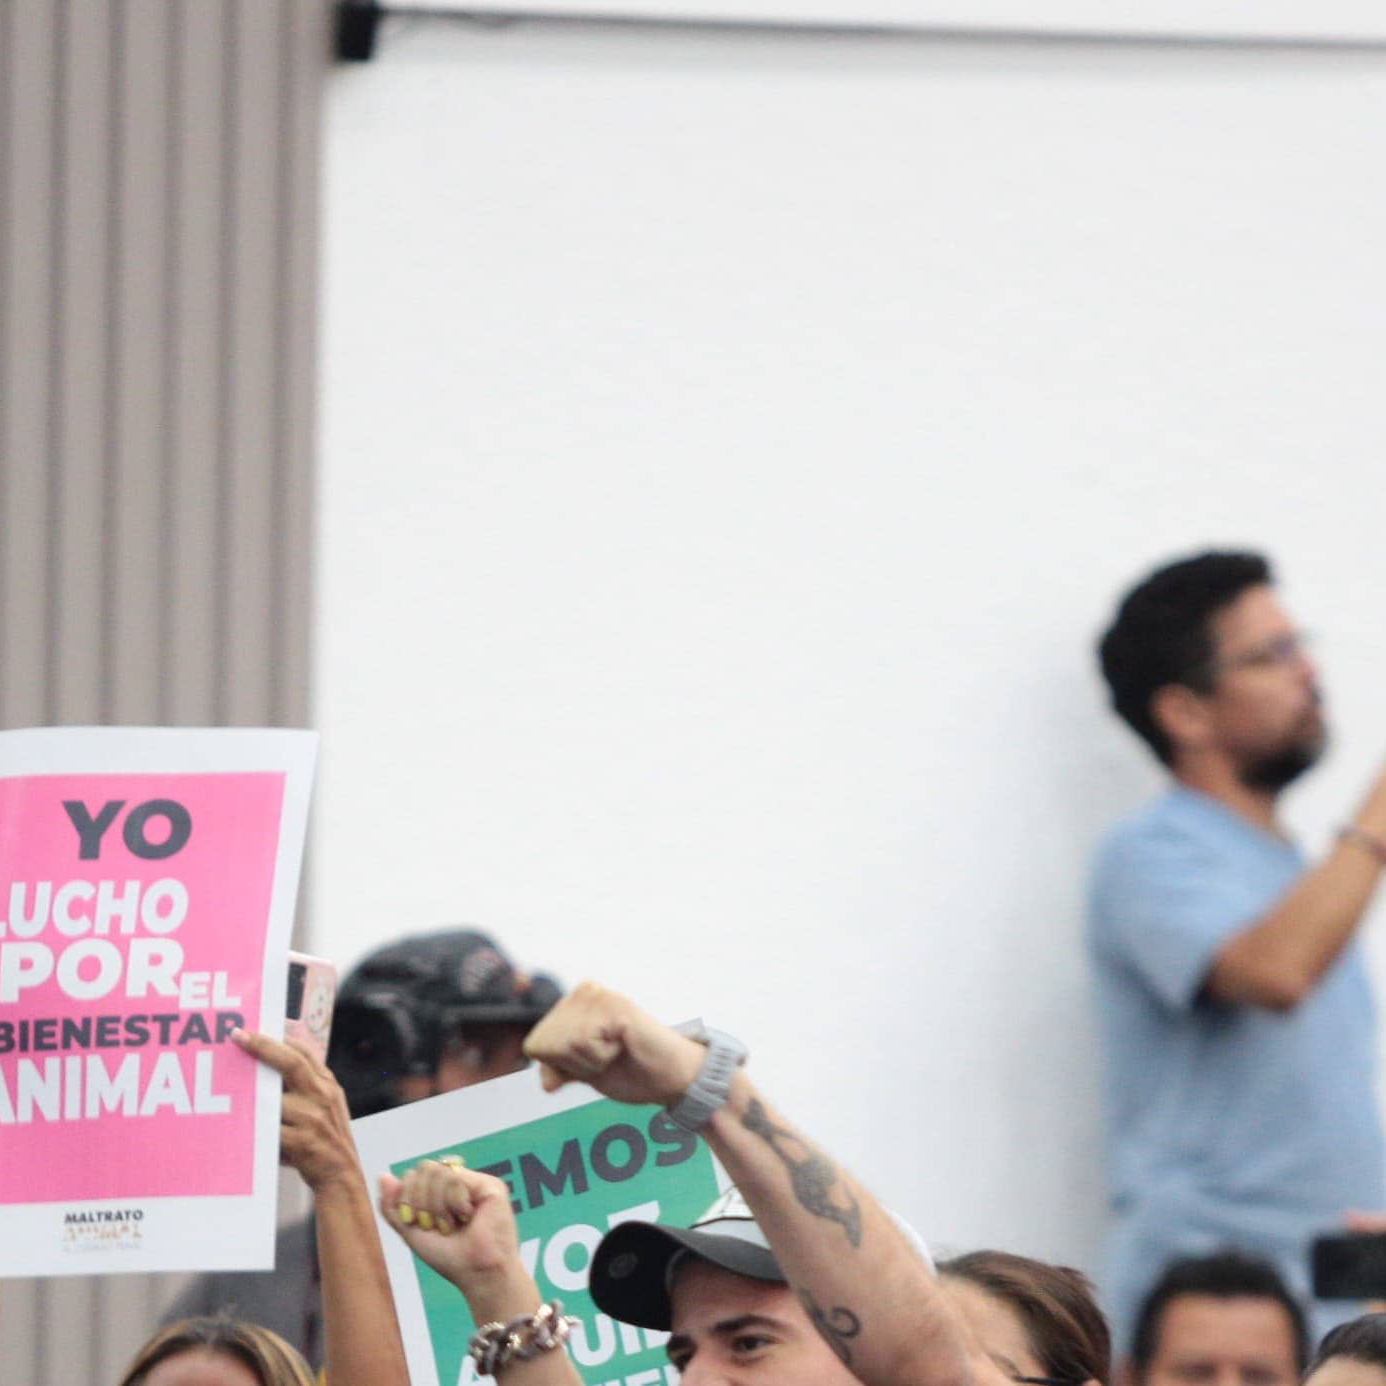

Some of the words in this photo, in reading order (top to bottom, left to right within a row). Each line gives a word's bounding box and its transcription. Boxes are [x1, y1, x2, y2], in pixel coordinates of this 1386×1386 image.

[62, 798, 192, 860] YO
[179, 971, 242, 1010] EL
[64, 1209, 144, 1224] MALTRATO
